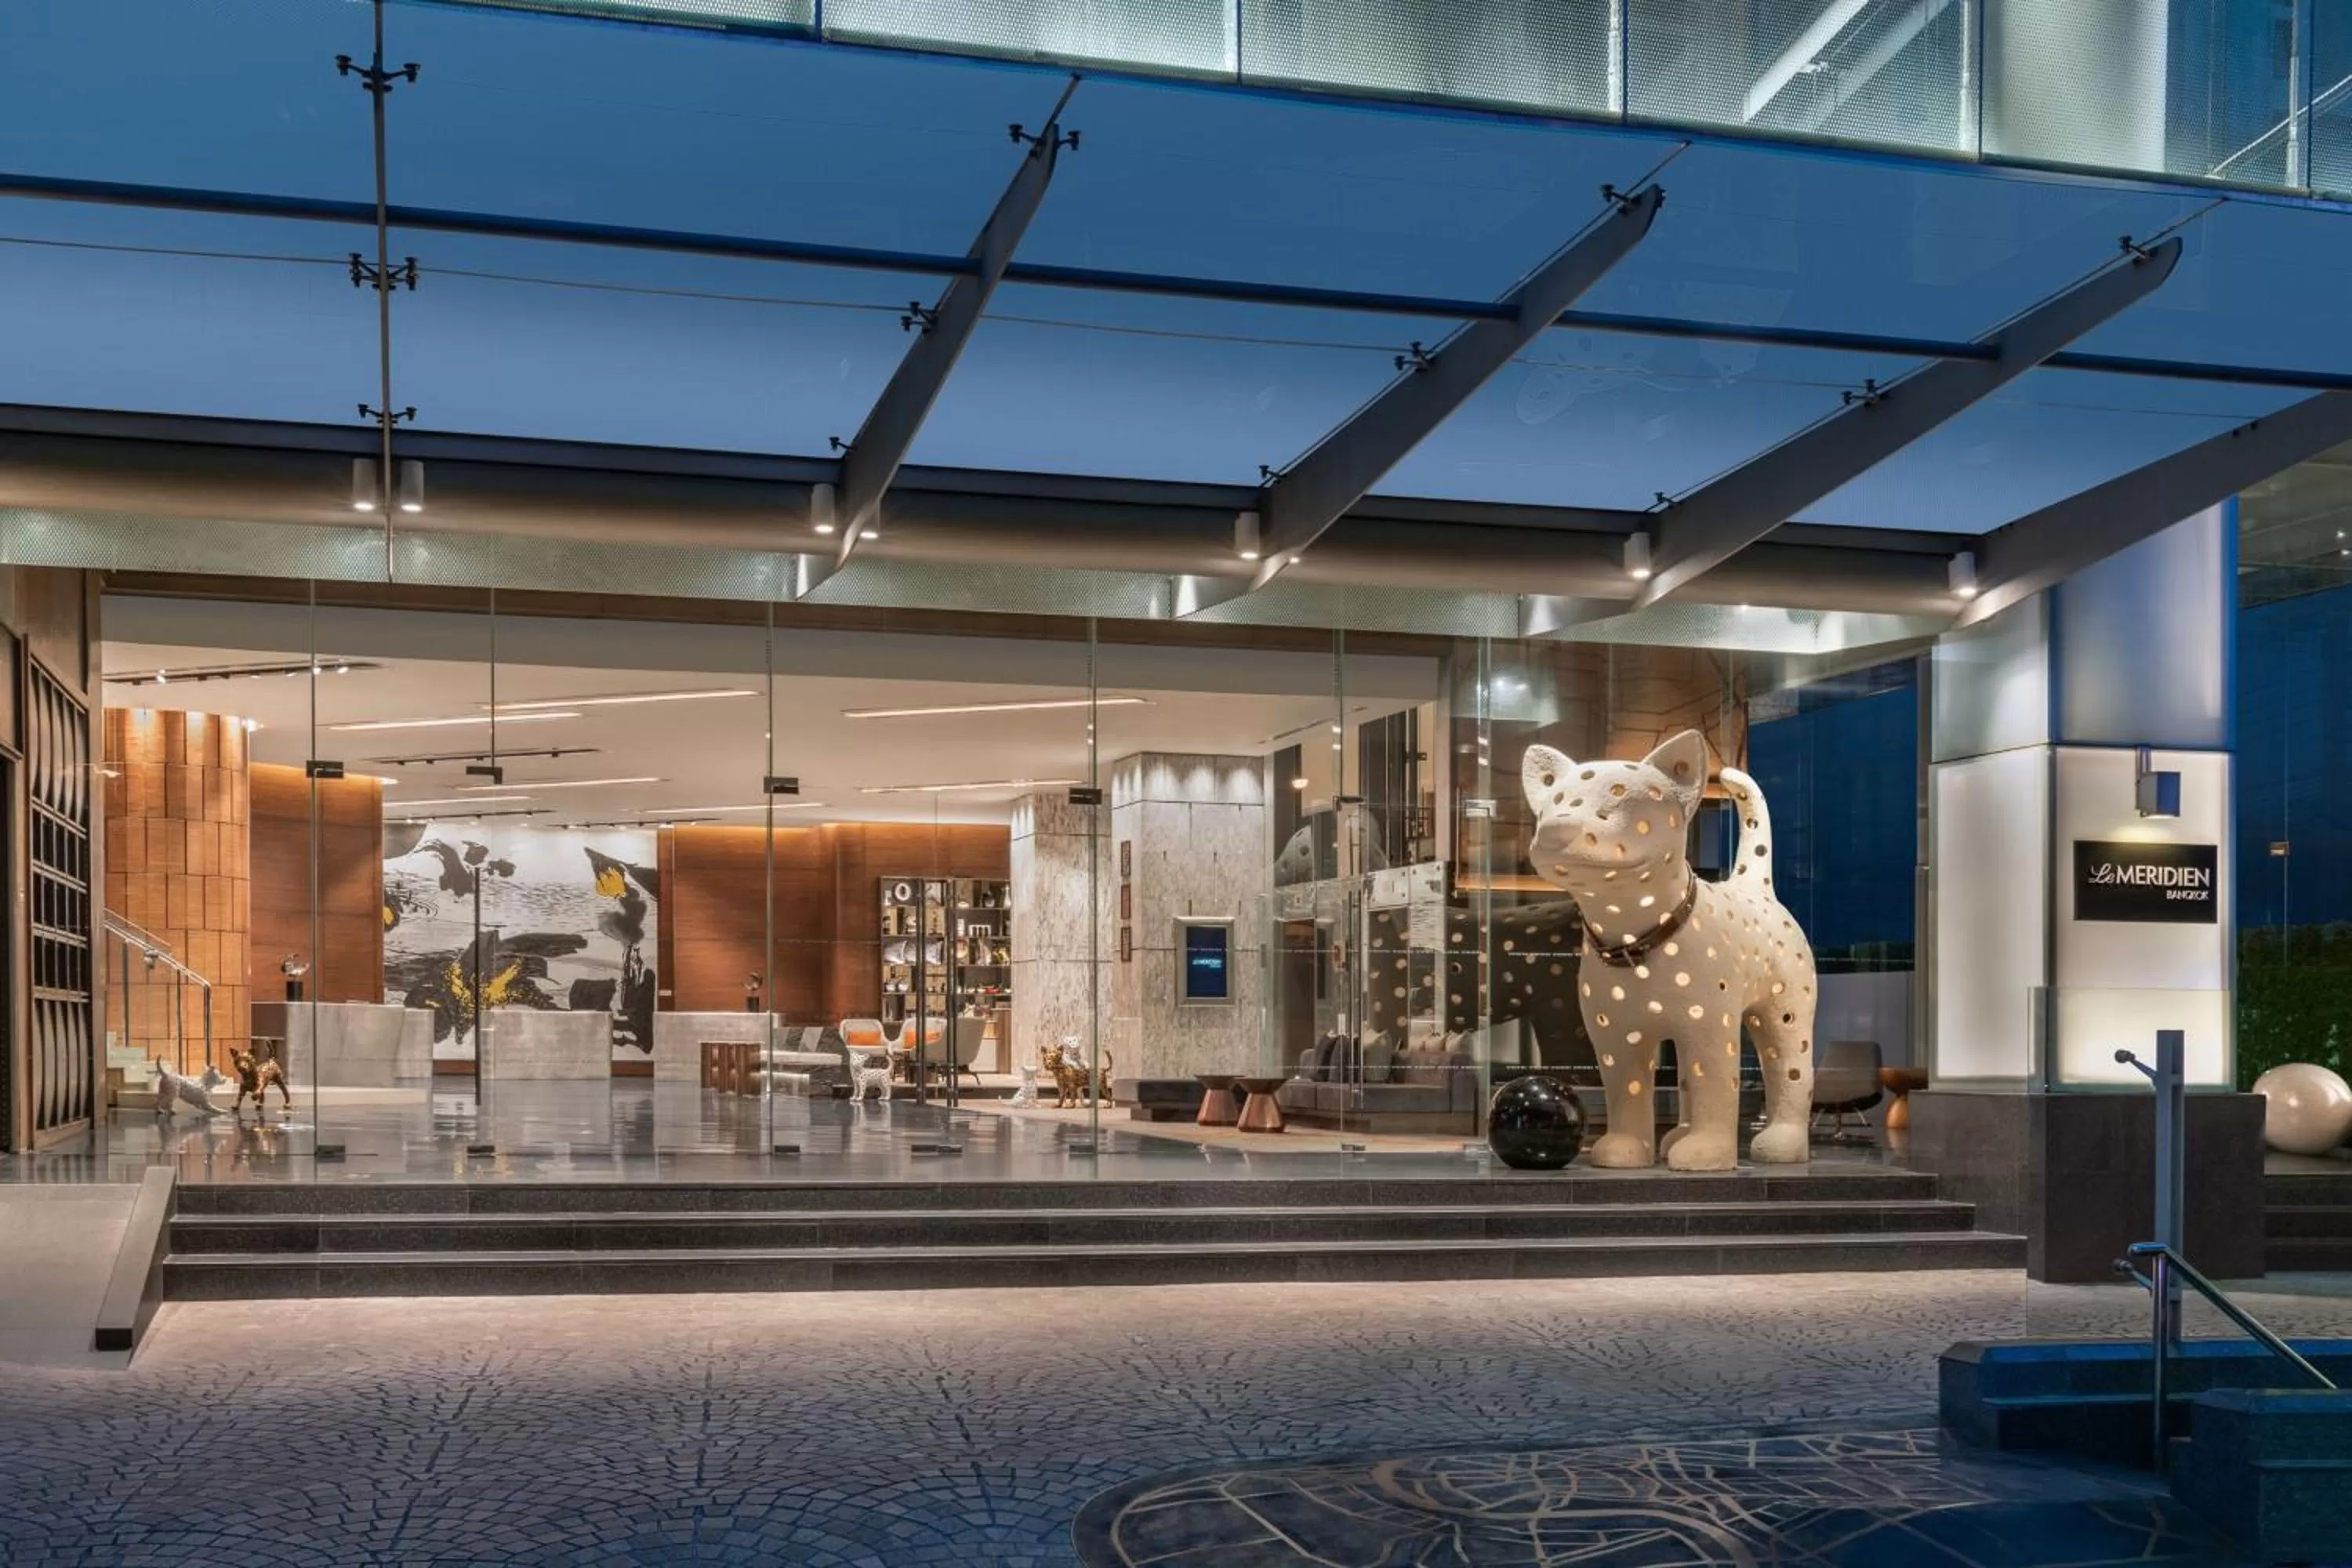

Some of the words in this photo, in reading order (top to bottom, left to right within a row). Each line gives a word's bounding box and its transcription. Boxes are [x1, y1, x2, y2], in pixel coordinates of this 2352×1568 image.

[2089, 863, 2114, 883] Le
[2117, 865, 2210, 887] MERIDIEN
[2166, 890, 2209, 900] BANGKOK
